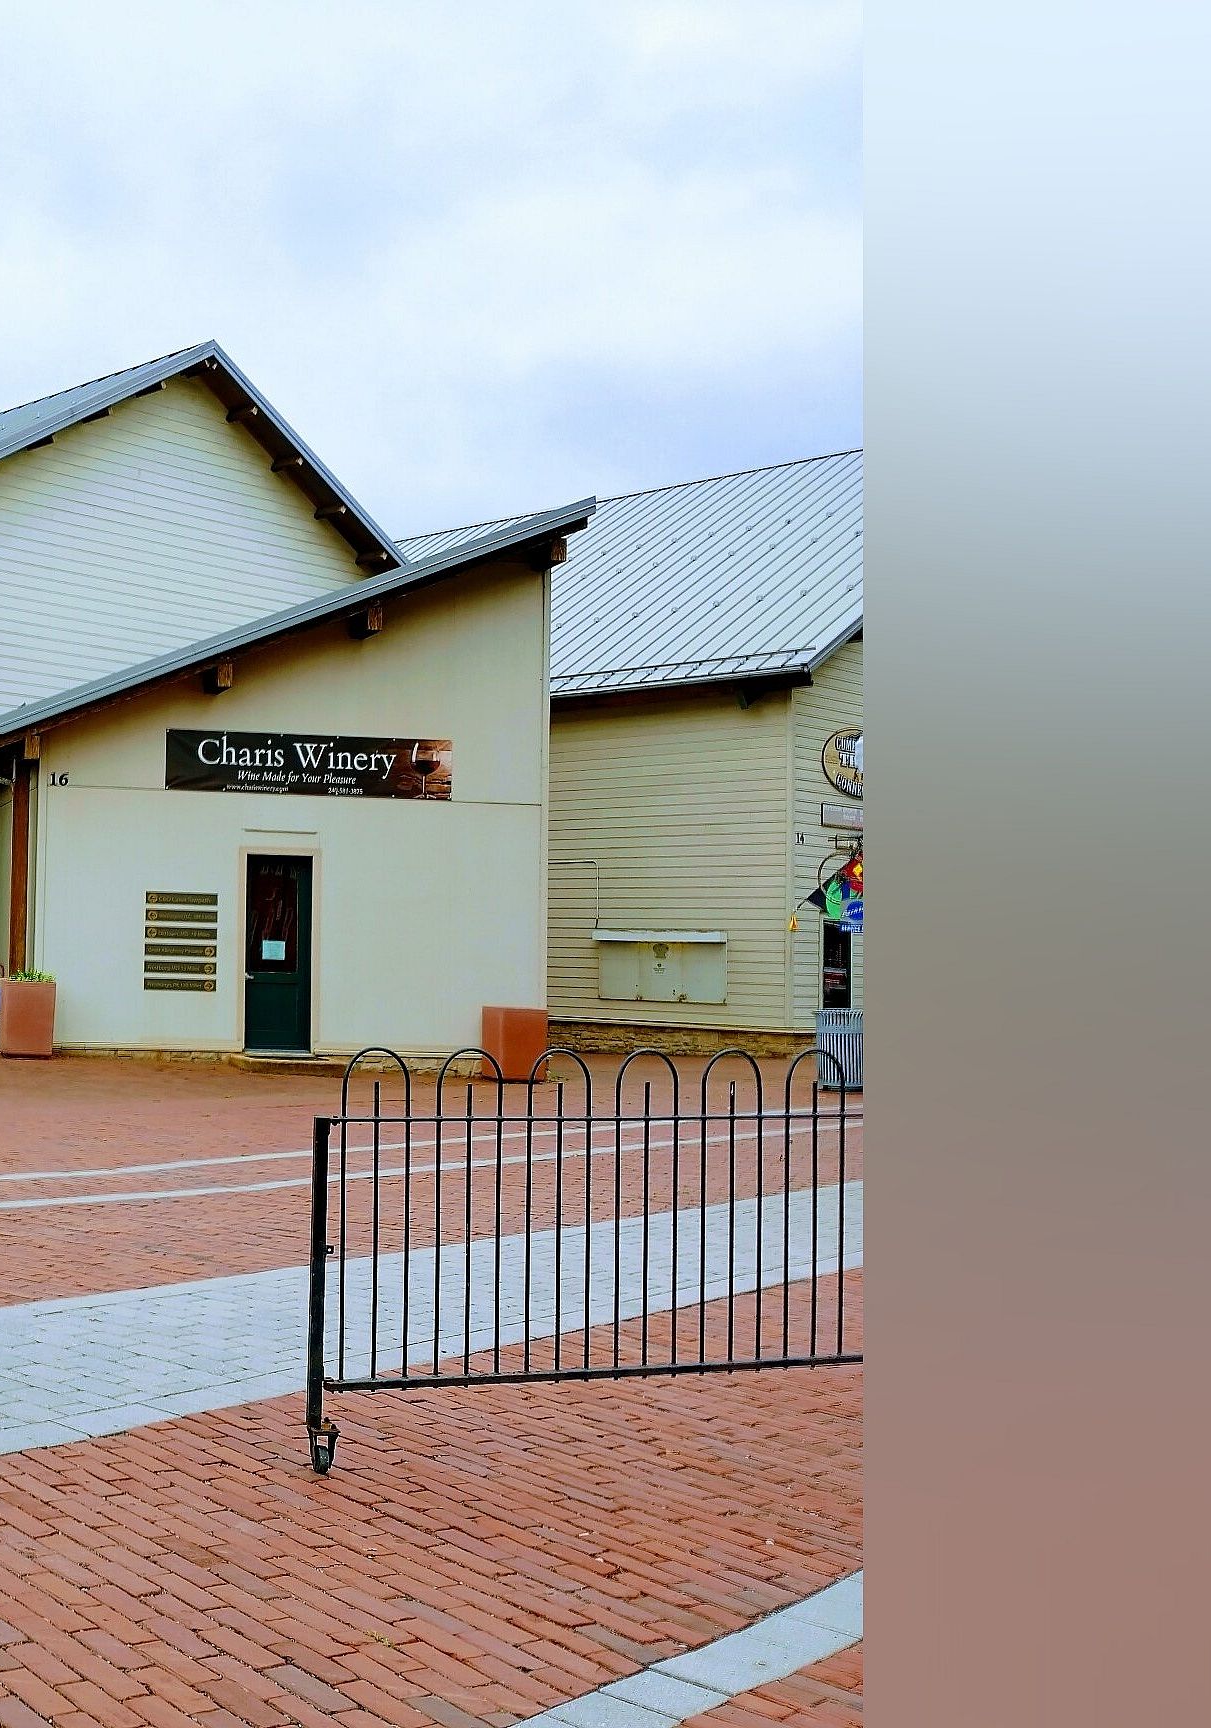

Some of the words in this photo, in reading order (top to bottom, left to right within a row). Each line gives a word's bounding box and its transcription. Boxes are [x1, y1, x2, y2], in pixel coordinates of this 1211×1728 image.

[197, 735, 285, 768] Charis
[292, 741, 397, 780] Winery
[50, 771, 69, 787] 16
[238, 769, 261, 781] Wine
[262, 770, 286, 782] Made
[286, 770, 300, 785] for
[302, 772, 322, 784] Your
[323, 772, 357, 785] Pleasure
